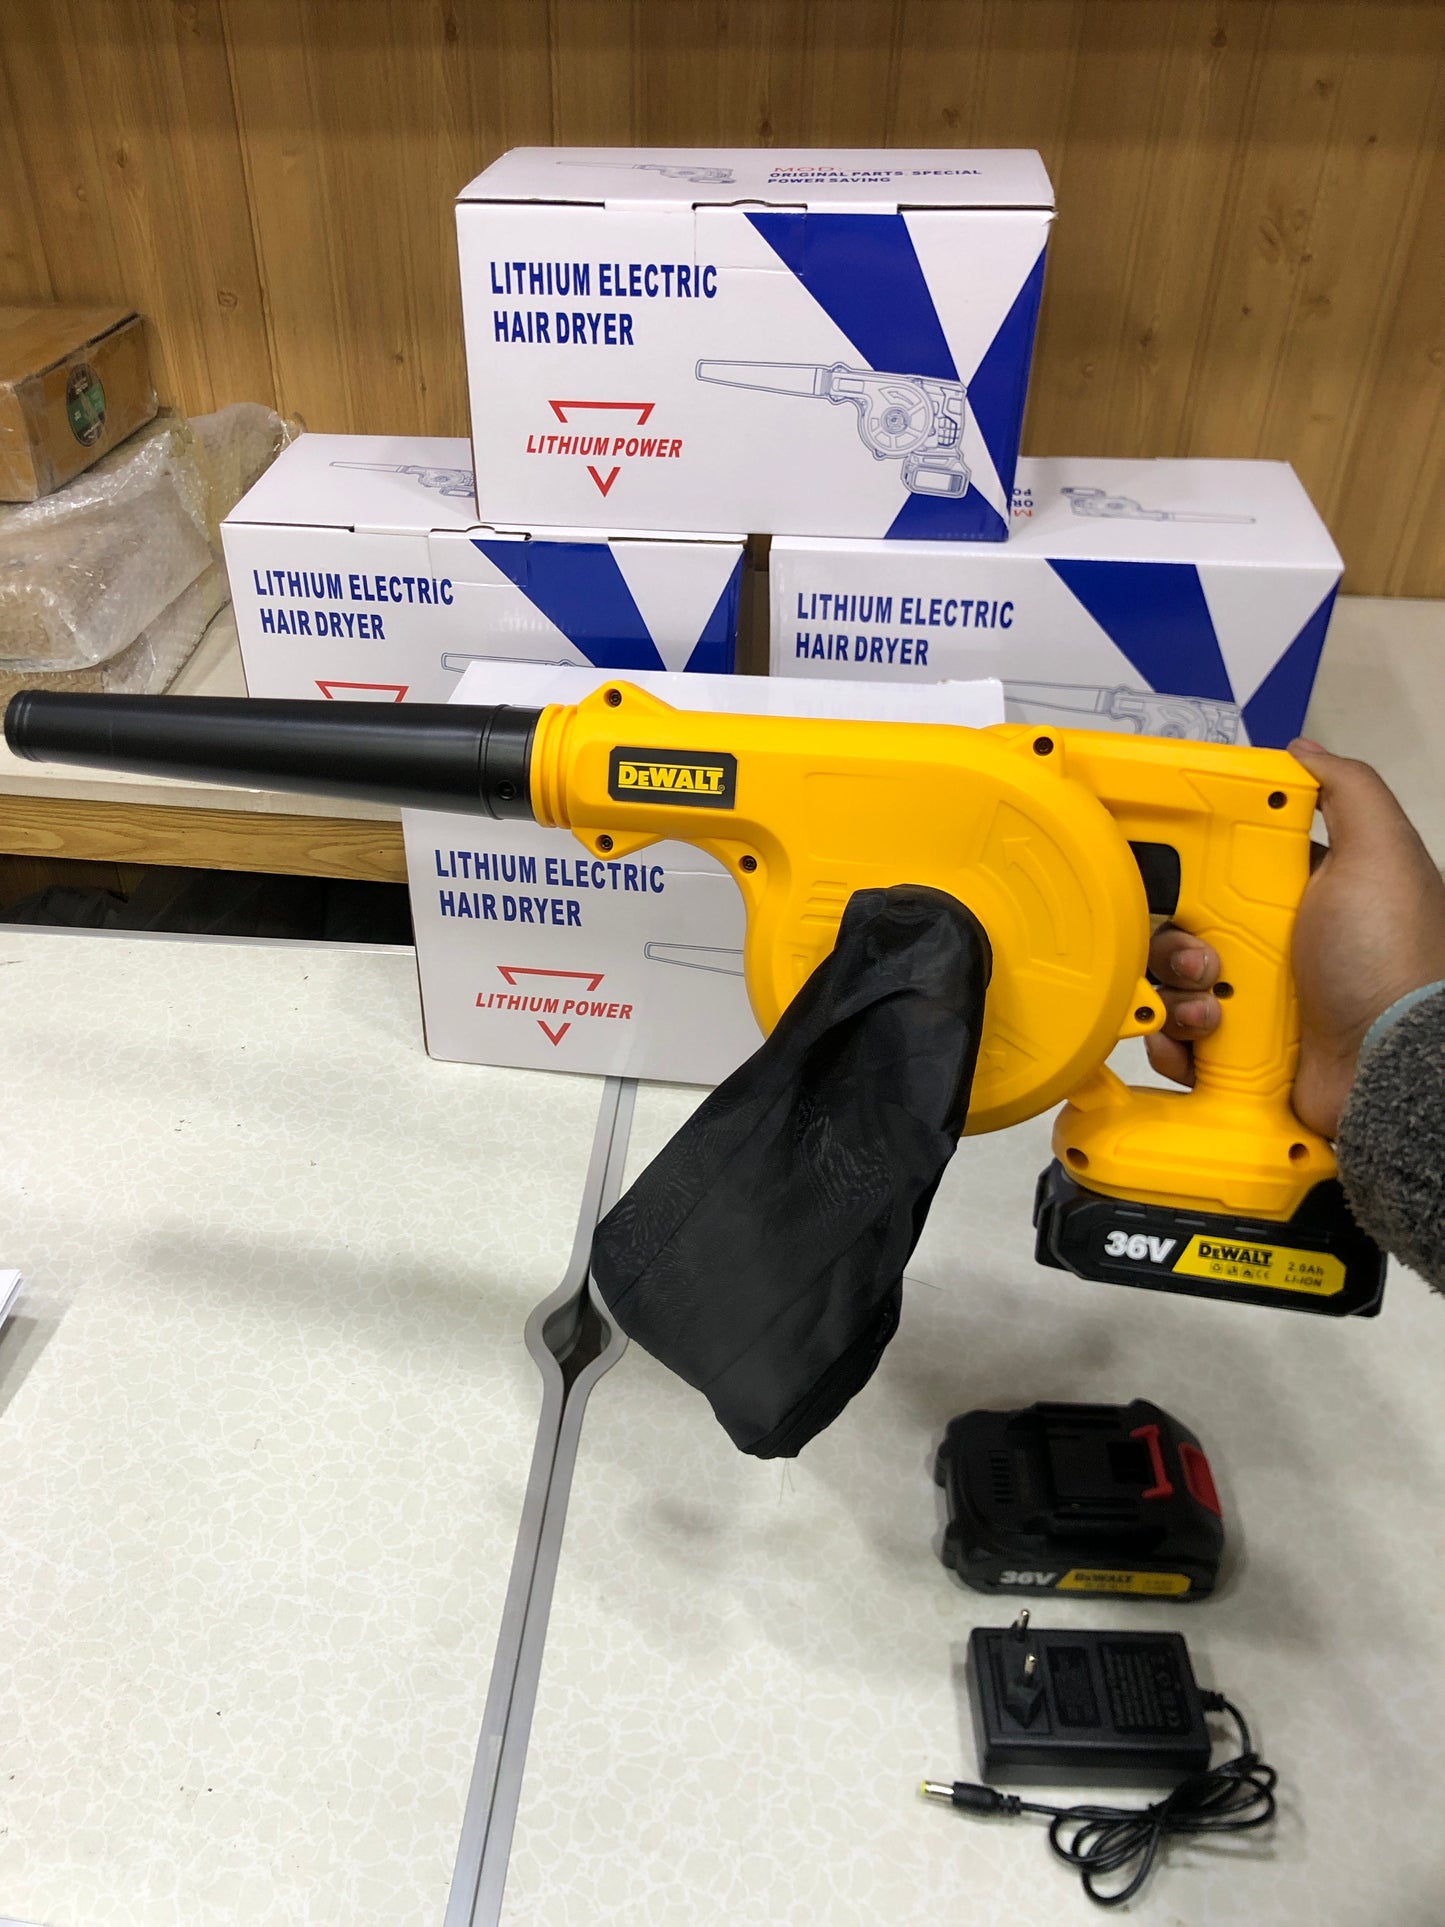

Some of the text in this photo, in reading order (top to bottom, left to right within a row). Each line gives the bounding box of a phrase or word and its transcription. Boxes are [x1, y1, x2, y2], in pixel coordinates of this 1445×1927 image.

[490, 261, 718, 299] LITHIUM ELECTRIC
[493, 310, 634, 347] HAIR DRYER
[526, 434, 683, 459] LITHIUM POWER
[253, 569, 455, 606] LITHIUM ELECTRIC
[260, 608, 385, 640] HAIR DRYER
[797, 592, 1015, 630] LITHIUM ELECTRIC
[795, 632, 929, 667] HAIR DRYER
[617, 764, 724, 792] DEWALT
[434, 849, 665, 894] LITHIUM ELECTRIC
[439, 889, 582, 928] HAIR DRYER
[475, 992, 633, 1020] LITHIUM POWER
[1103, 1230, 1178, 1265] 36V
[1197, 1243, 1273, 1265] DEWALT
[1000, 1570, 1057, 1586] 36V
